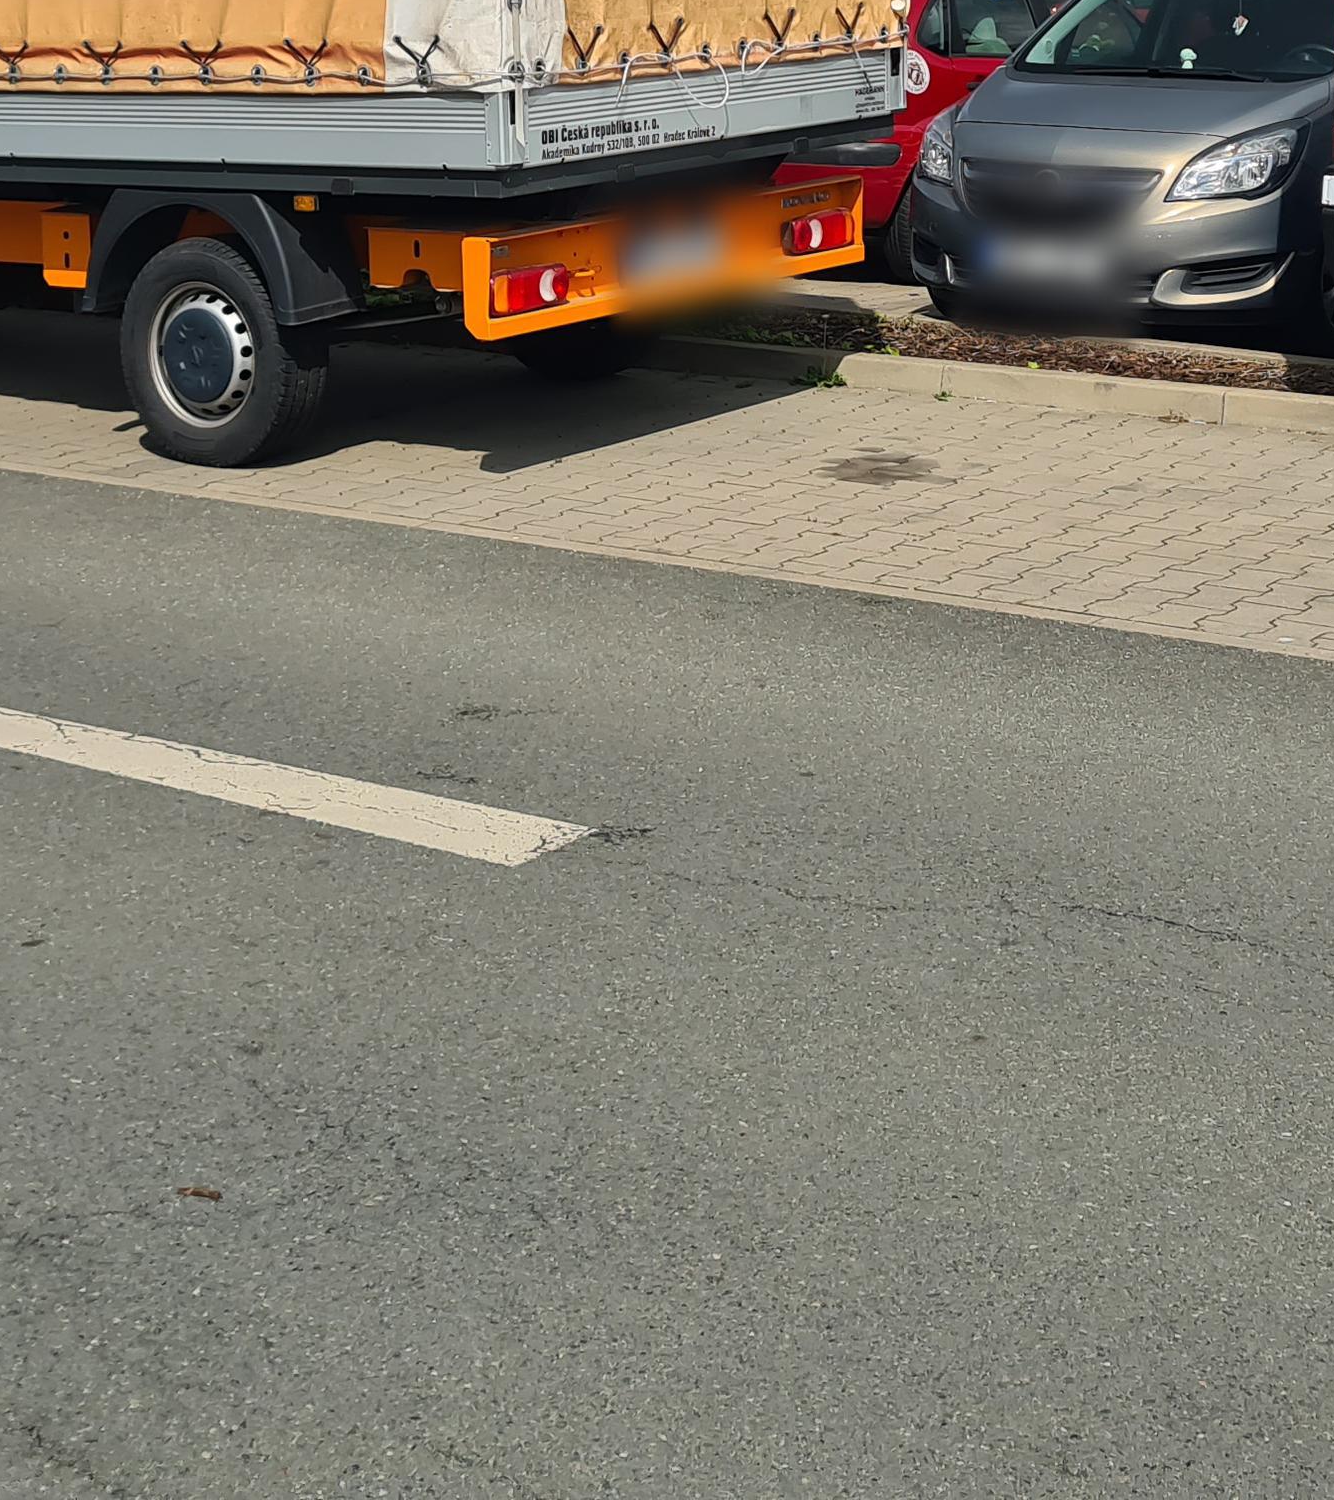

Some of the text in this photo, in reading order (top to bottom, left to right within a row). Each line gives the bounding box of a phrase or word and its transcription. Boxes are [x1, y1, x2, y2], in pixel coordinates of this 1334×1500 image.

[541, 118, 660, 145] OBI Česká republika s. r. o.
[663, 130, 686, 143] Hradec
